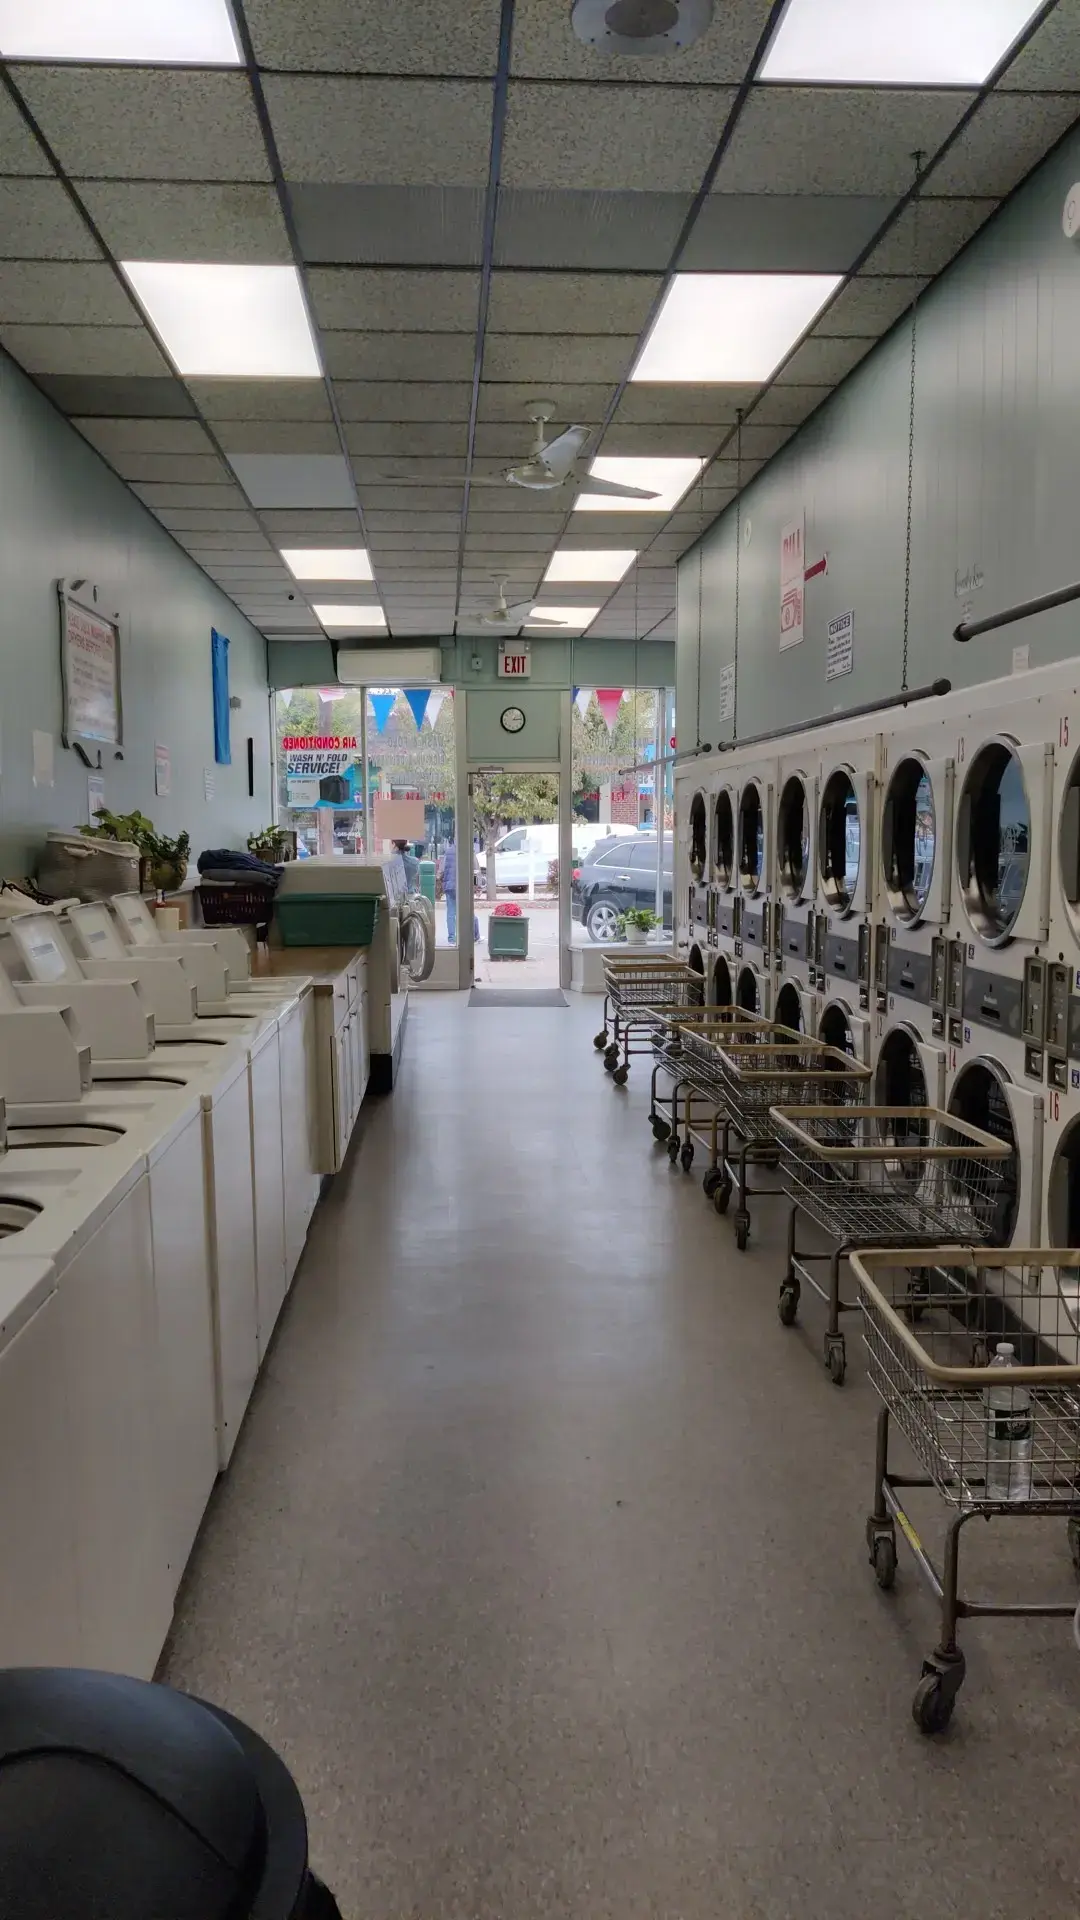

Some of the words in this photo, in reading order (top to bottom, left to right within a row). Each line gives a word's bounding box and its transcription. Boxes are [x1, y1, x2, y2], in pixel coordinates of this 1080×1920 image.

[830, 616, 850, 635] NOTICE
[504, 656, 526, 673] EXIT
[1059, 716, 1069, 748] 15
[289, 754, 313, 762] WASH
[326, 754, 348, 762] FOLD
[957, 737, 965, 764] 13
[287, 762, 340, 774] SERVICE!
[949, 1047, 957, 1072] 14
[1050, 1091, 1060, 1122] 16
